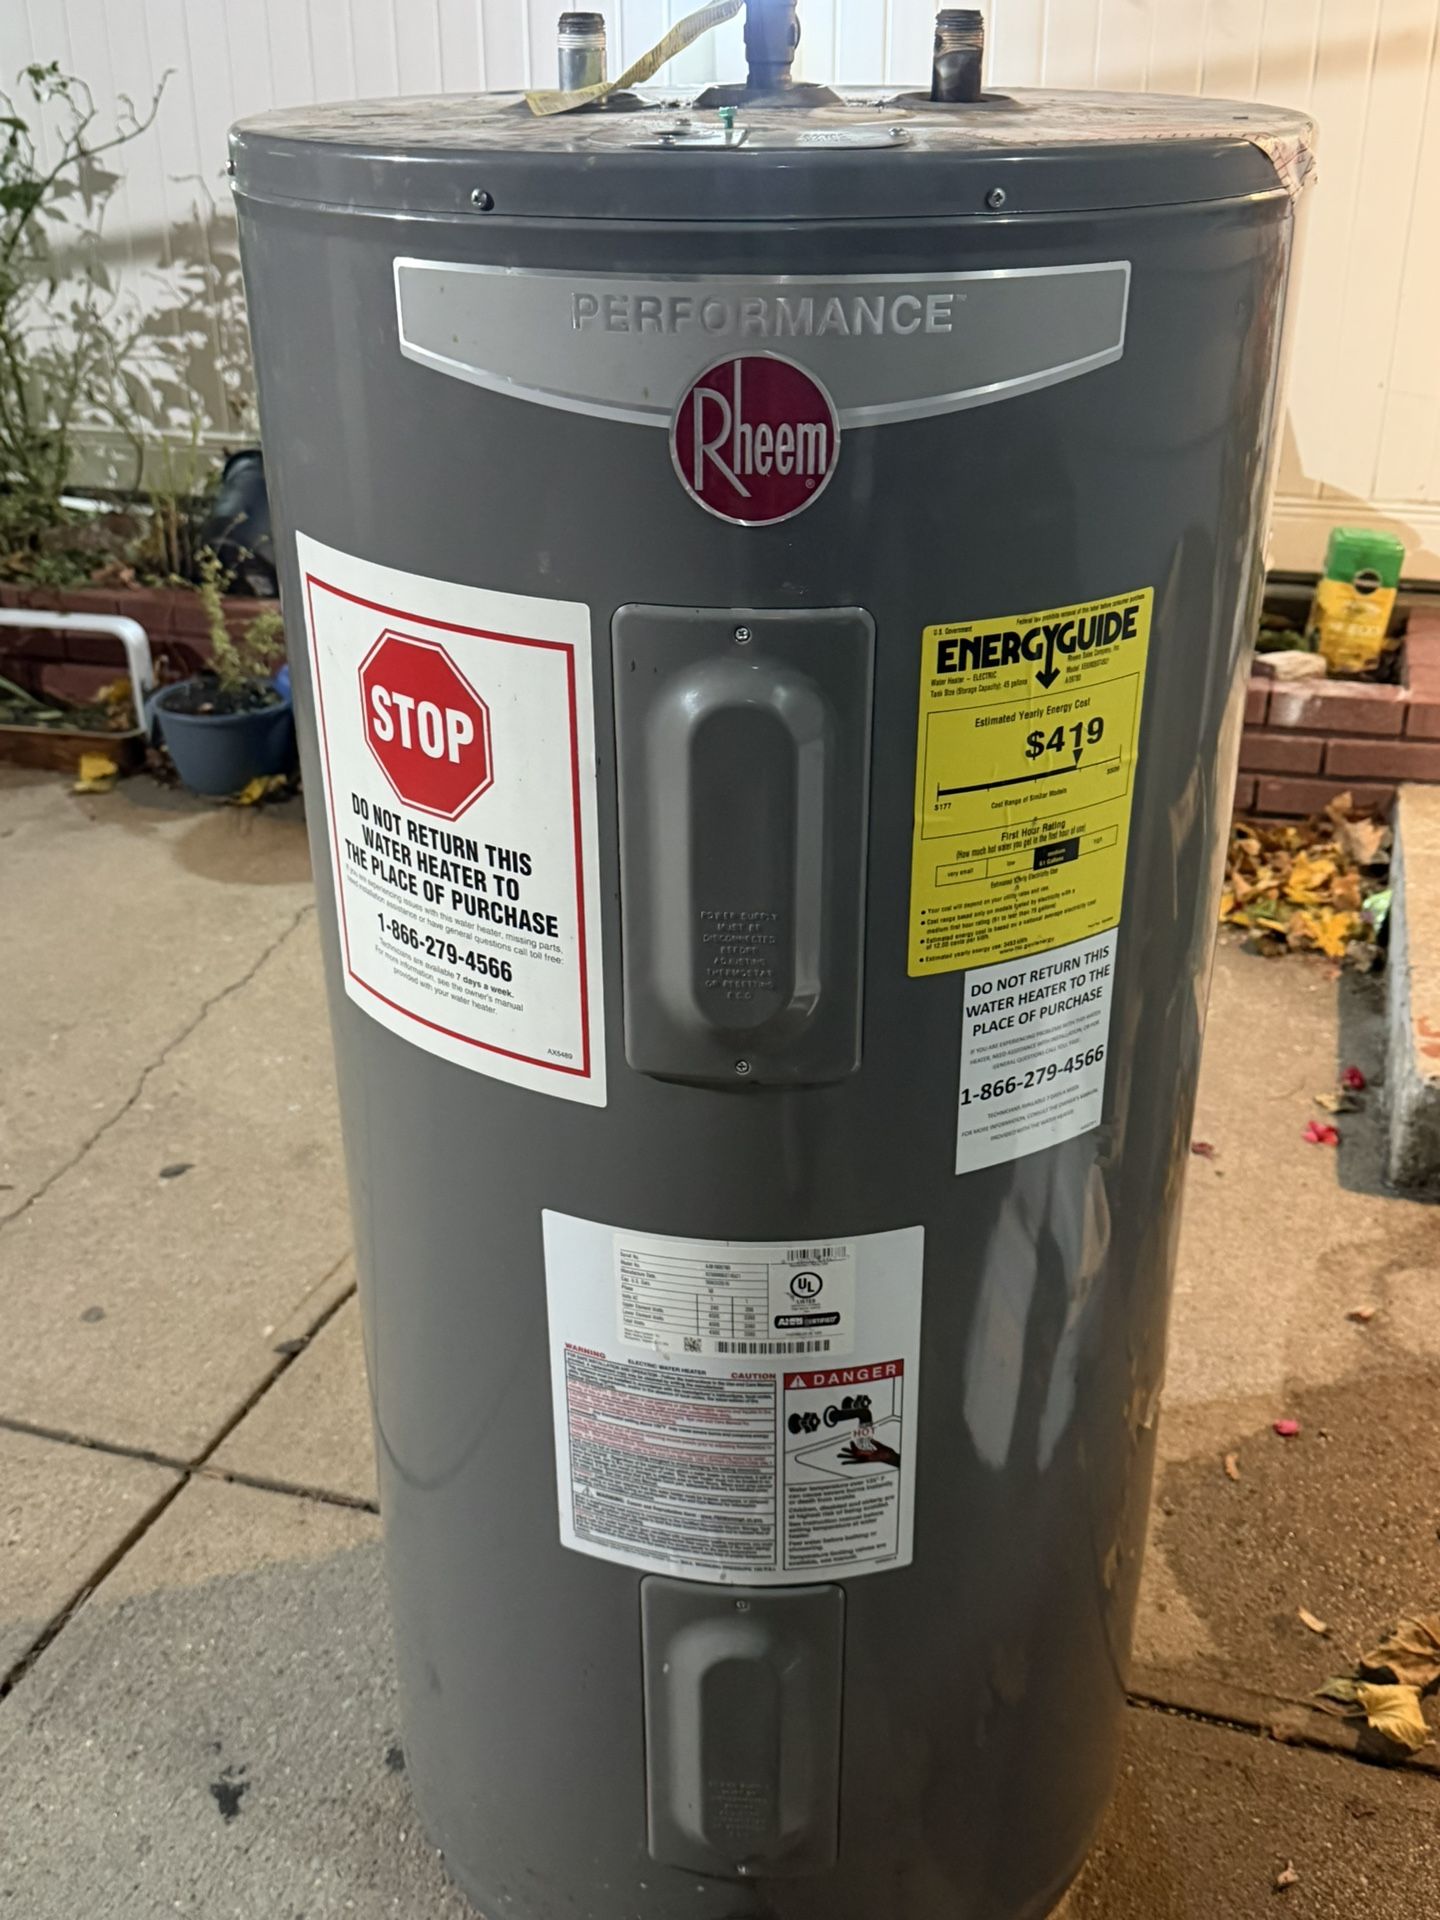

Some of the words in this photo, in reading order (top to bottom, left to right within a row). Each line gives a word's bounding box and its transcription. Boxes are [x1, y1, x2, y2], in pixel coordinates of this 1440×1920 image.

[570, 292, 954, 336] PERFORMANCE
[694, 359, 828, 499] Rheem
[937, 605, 1139, 676] ENERGYGUIDE
[944, 626, 973, 635] Government
[930, 678, 947, 687] Water
[947, 676, 964, 684] Heater
[972, 671, 997, 681] ELECTRIC
[930, 690, 943, 698] Tank
[944, 688, 955, 697] Size
[370, 684, 474, 764] STOP
[975, 712, 1016, 728] Estimated
[1018, 708, 1044, 721] Yearly
[1046, 702, 1072, 716] Energy
[1074, 698, 1091, 709] Cost
[1024, 716, 1105, 761] $419
[934, 801, 952, 812] $177
[1004, 798, 1022, 808] Range
[1022, 796, 1029, 804] of
[1030, 792, 1048, 802] Similar
[1048, 787, 1067, 798] Models
[351, 791, 369, 821] DO
[372, 800, 402, 837] NOT
[407, 818, 479, 863] RETURN
[484, 843, 533, 876] THIS
[971, 845, 987, 857] much
[987, 844, 997, 854] hot
[997, 842, 1012, 853] water
[1012, 841, 1023, 851] you
[1023, 838, 1033, 849] get
[1038, 834, 1048, 842] the
[1000, 831, 1019, 842] First
[1021, 826, 1040, 837] Hour
[1042, 820, 1066, 833] Rating
[361, 823, 412, 868] WATER
[417, 850, 487, 893] HEATER
[492, 873, 520, 901] TO
[947, 870, 959, 878] very
[960, 867, 974, 876] small
[344, 837, 369, 871] THE
[371, 856, 419, 896] PLACE
[423, 879, 446, 906] OF
[451, 889, 559, 939] PURCHASE
[367, 878, 403, 904] experiencing
[403, 898, 423, 912] issues
[424, 906, 439, 918] with
[439, 912, 453, 924] this
[454, 917, 475, 930] water
[476, 924, 504, 940] heater,
[505, 932, 538, 949] missing
[386, 900, 418, 921] assistance
[427, 918, 444, 931] have
[444, 925, 473, 940] general
[474, 934, 512, 953] questions
[513, 946, 528, 956] call
[529, 950, 543, 960] toll
[377, 912, 513, 983] 1-866-279-4566
[384, 951, 399, 965] more
[437, 977, 451, 988] see
[451, 983, 464, 993] the
[464, 987, 494, 1004] owner's
[494, 997, 524, 1012] manual
[393, 966, 419, 986] provided
[420, 980, 433, 990] with
[434, 985, 449, 998] your
[451, 993, 471, 1005] water
[471, 999, 498, 1015] heater.
[413, 957, 424, 965] are
[424, 960, 455, 979] available
[456, 972, 461, 981] 7
[463, 976, 482, 989] days
[483, 983, 489, 991] a
[490, 984, 515, 999] week.
[965, 995, 1014, 1019] WATER
[1018, 981, 1067, 1007] HEATER
[1070, 973, 1086, 989] TO
[1089, 963, 1111, 983] THE
[970, 981, 993, 998] DO
[996, 973, 1027, 992] NOT
[1030, 955, 1081, 984] RETURN
[1084, 945, 1110, 965] THIS
[972, 1015, 1015, 1037] PLACE
[1018, 1010, 1037, 1026] OF
[1039, 986, 1104, 1023] PURCHASE
[960, 1044, 1105, 1107] 1-866-279-4566
[798, 1278, 815, 1293] UL
[564, 1342, 607, 1360] WARNING
[627, 1358, 657, 1369] ELECTRIC
[658, 1364, 681, 1373] WATER
[681, 1367, 707, 1376] HEATER
[730, 1371, 777, 1380] CAUTION
[813, 1364, 897, 1386] DANGER
[853, 1426, 876, 1438] HOT
